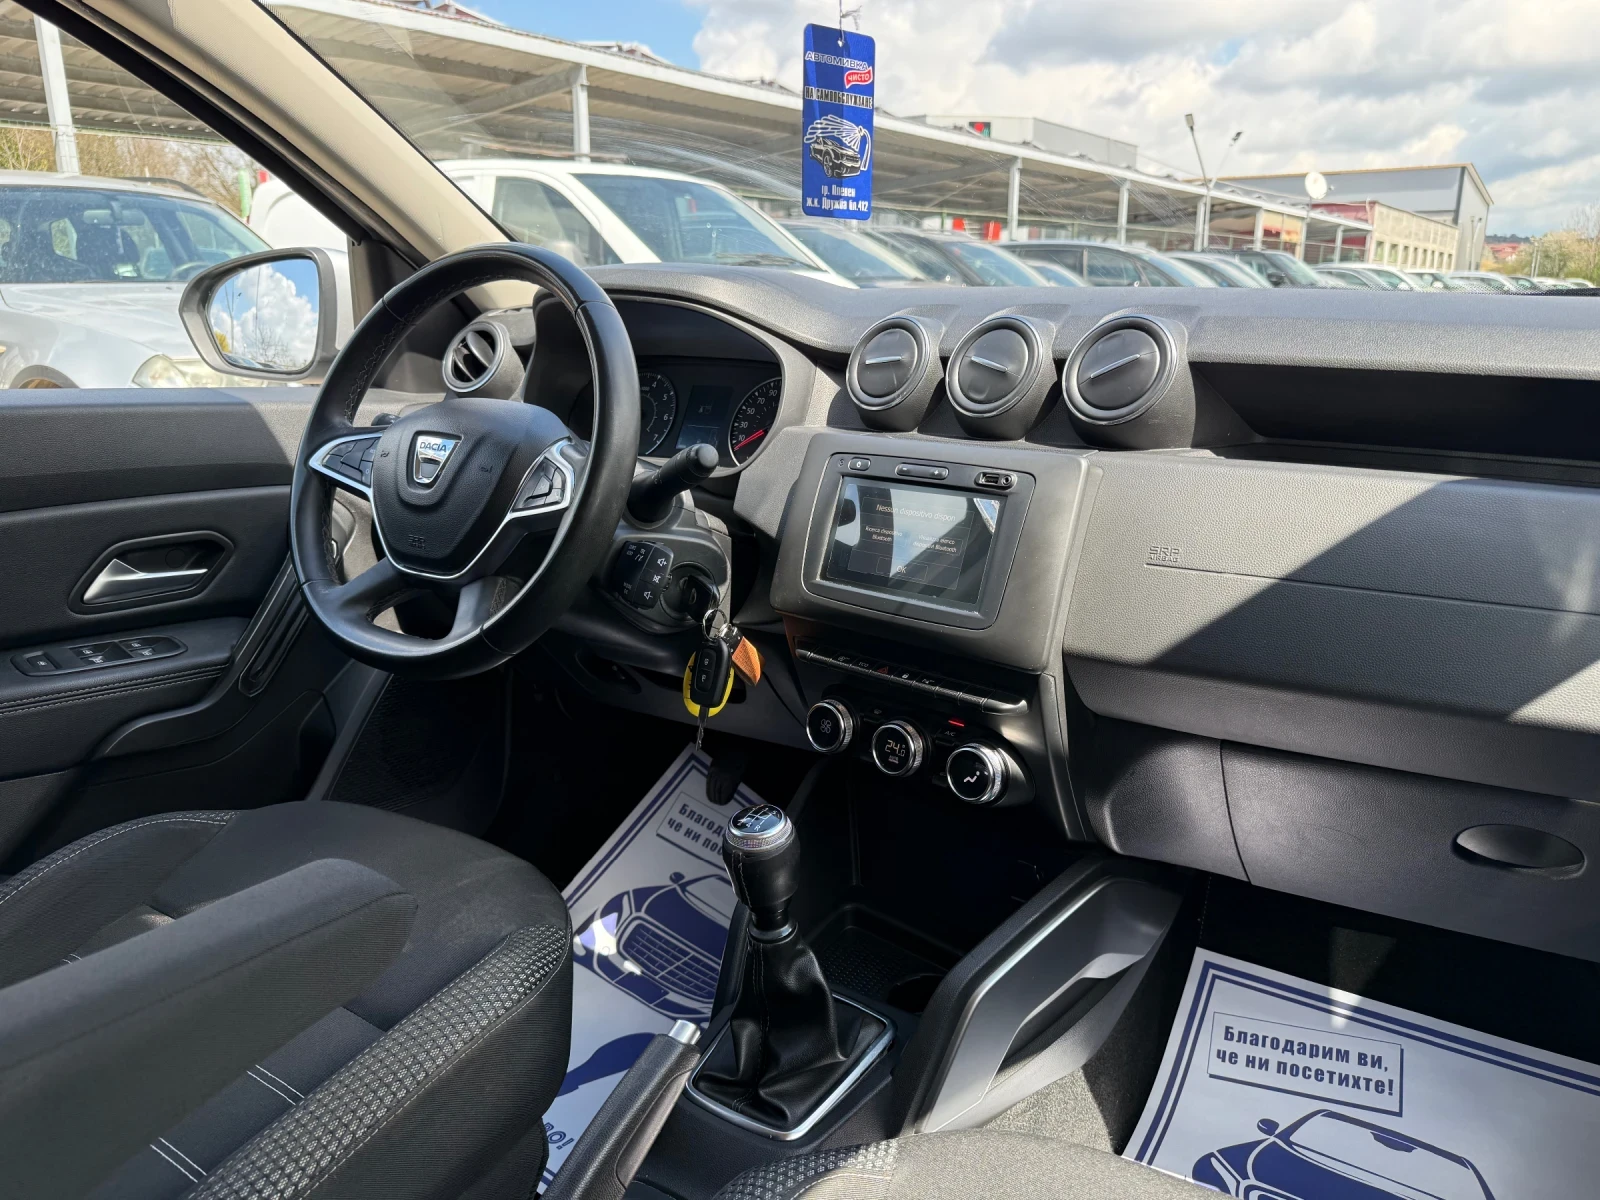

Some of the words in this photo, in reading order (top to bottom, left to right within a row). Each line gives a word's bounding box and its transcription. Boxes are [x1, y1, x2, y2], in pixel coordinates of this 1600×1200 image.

[805, 51, 868, 70] АВТОМИВКА
[848, 73, 869, 81] ЧИСТО
[805, 86, 814, 100] НА
[832, 184, 856, 197] Плевен
[822, 197, 847, 210] Дружба
[769, 389, 777, 397] 90
[420, 441, 447, 452] DACIA
[876, 504, 898, 514] Nessun
[900, 508, 932, 519] dispositivo
[934, 512, 956, 522] dispon
[896, 565, 907, 573] OK
[667, 817, 683, 833] че
[684, 827, 702, 843] ни
[1223, 1025, 1350, 1064] Благодарим
[1357, 1051, 1388, 1072] ви,
[1216, 1049, 1239, 1065] че
[1245, 1054, 1270, 1072] ни
[1276, 1060, 1394, 1096] посетихте!
